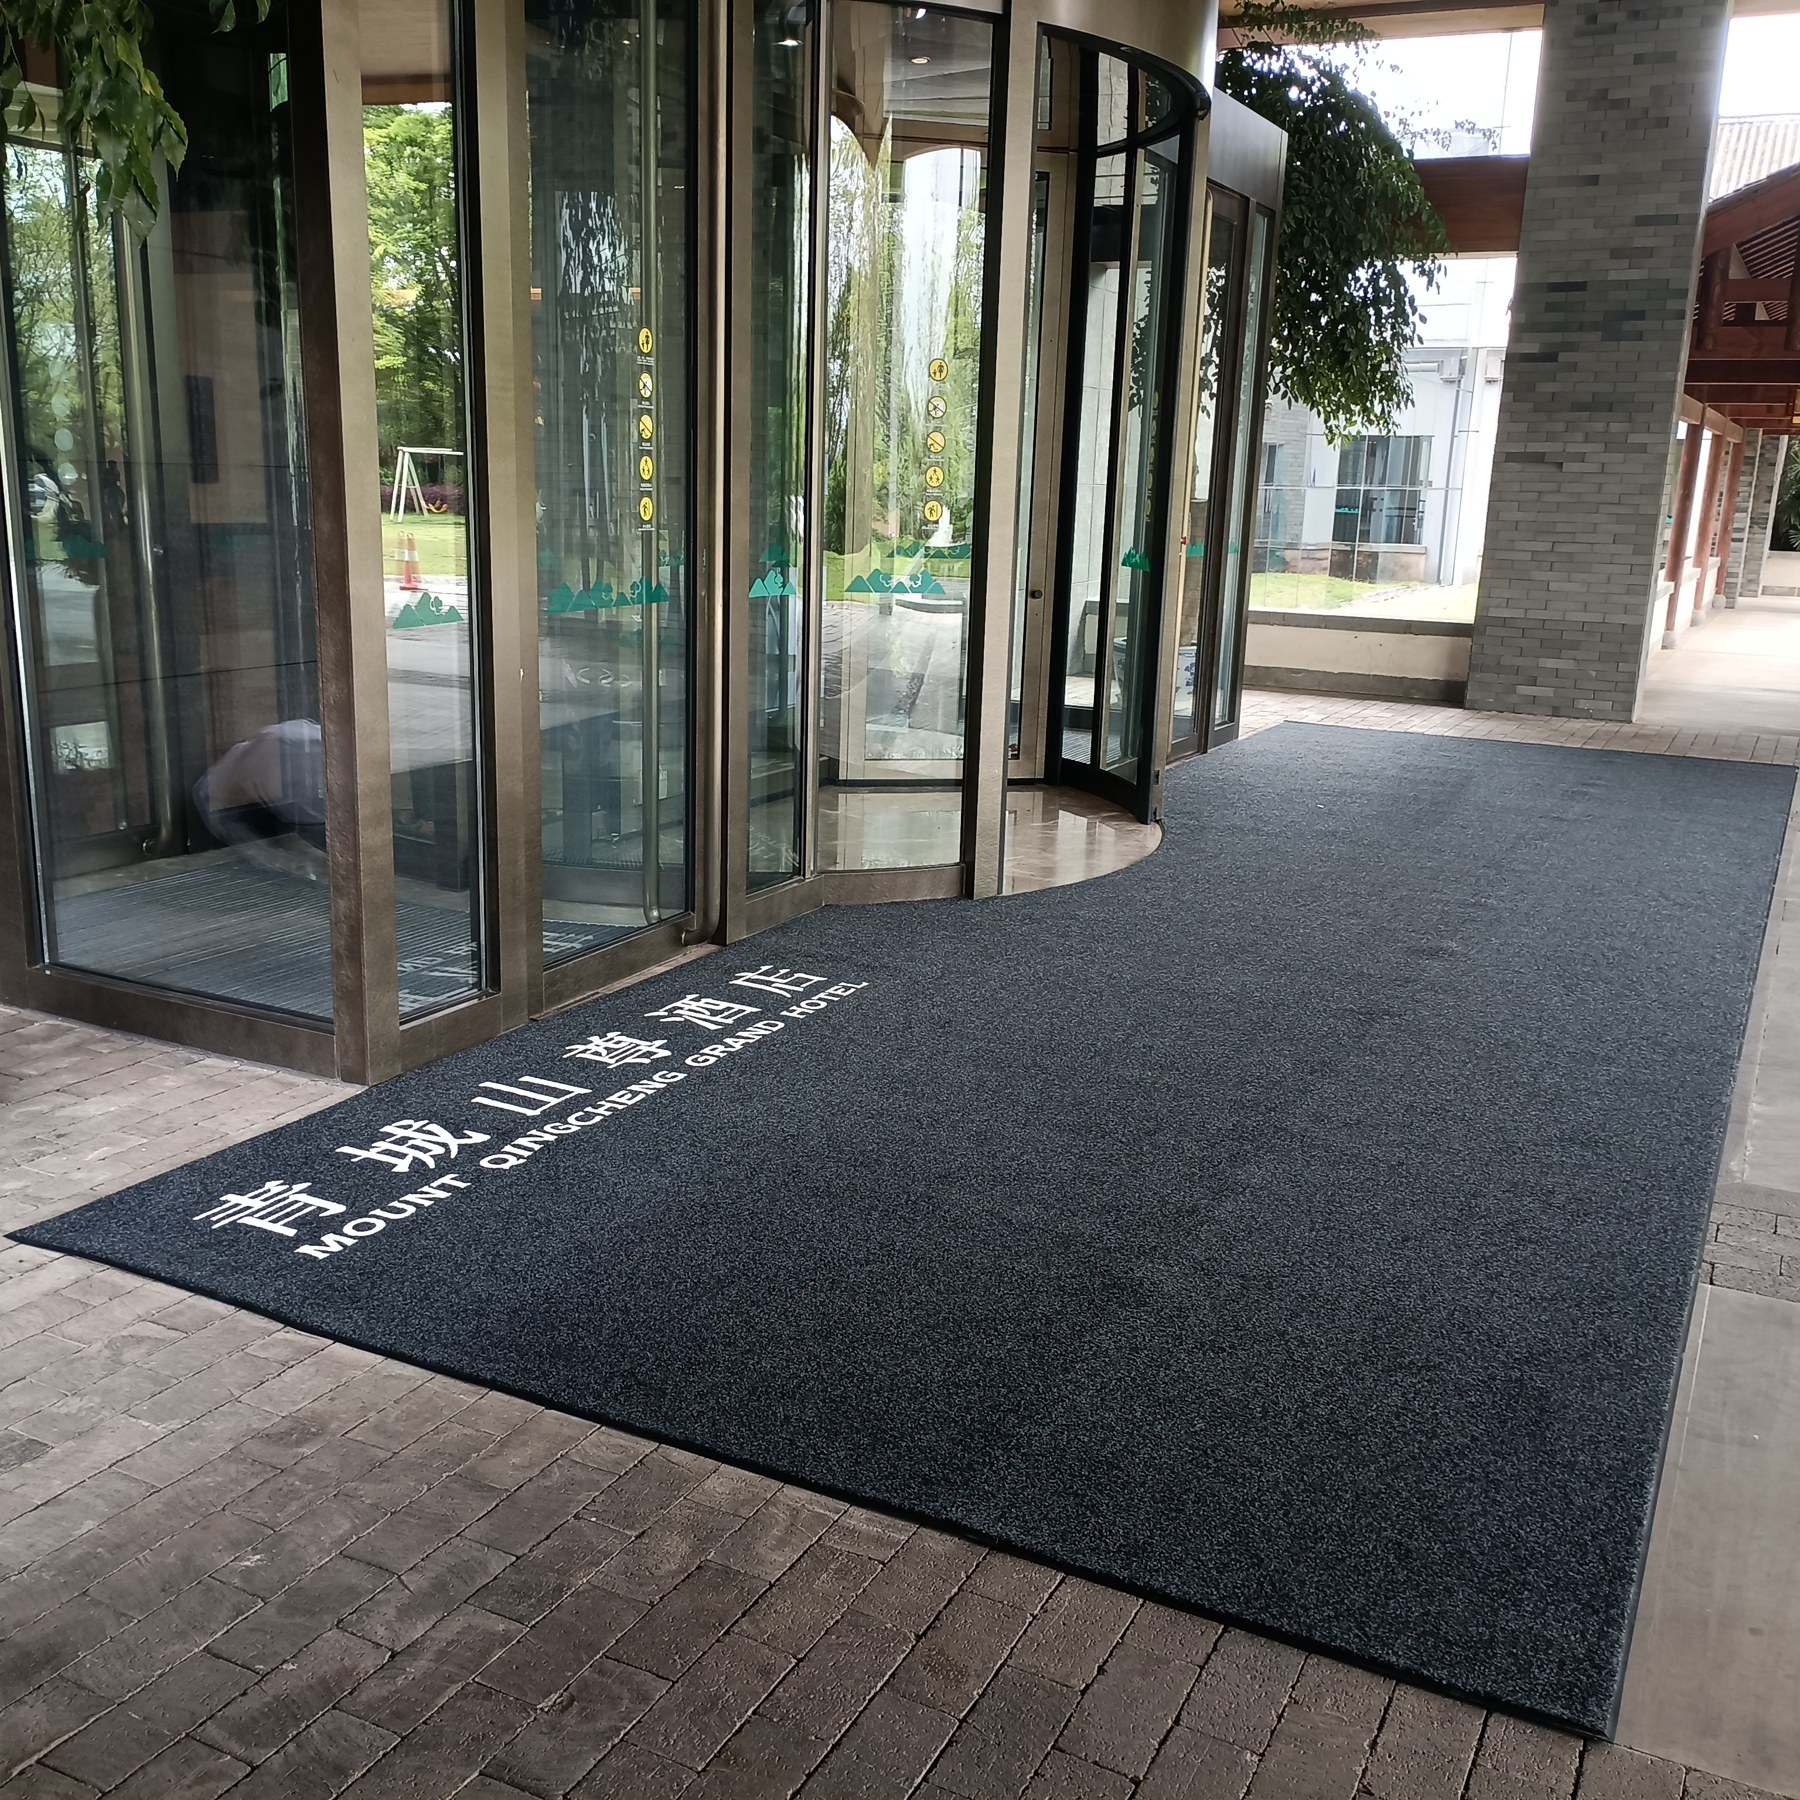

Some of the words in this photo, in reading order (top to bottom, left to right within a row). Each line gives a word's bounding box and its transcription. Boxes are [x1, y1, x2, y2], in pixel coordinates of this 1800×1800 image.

[193, 964, 828, 1237] 青城山尊酒店
[294, 1173, 472, 1260] MOUNT
[479, 1070, 688, 1170] QINGCHENG
[684, 1019, 785, 1068] GRAND
[779, 980, 870, 1019] HOTEL
